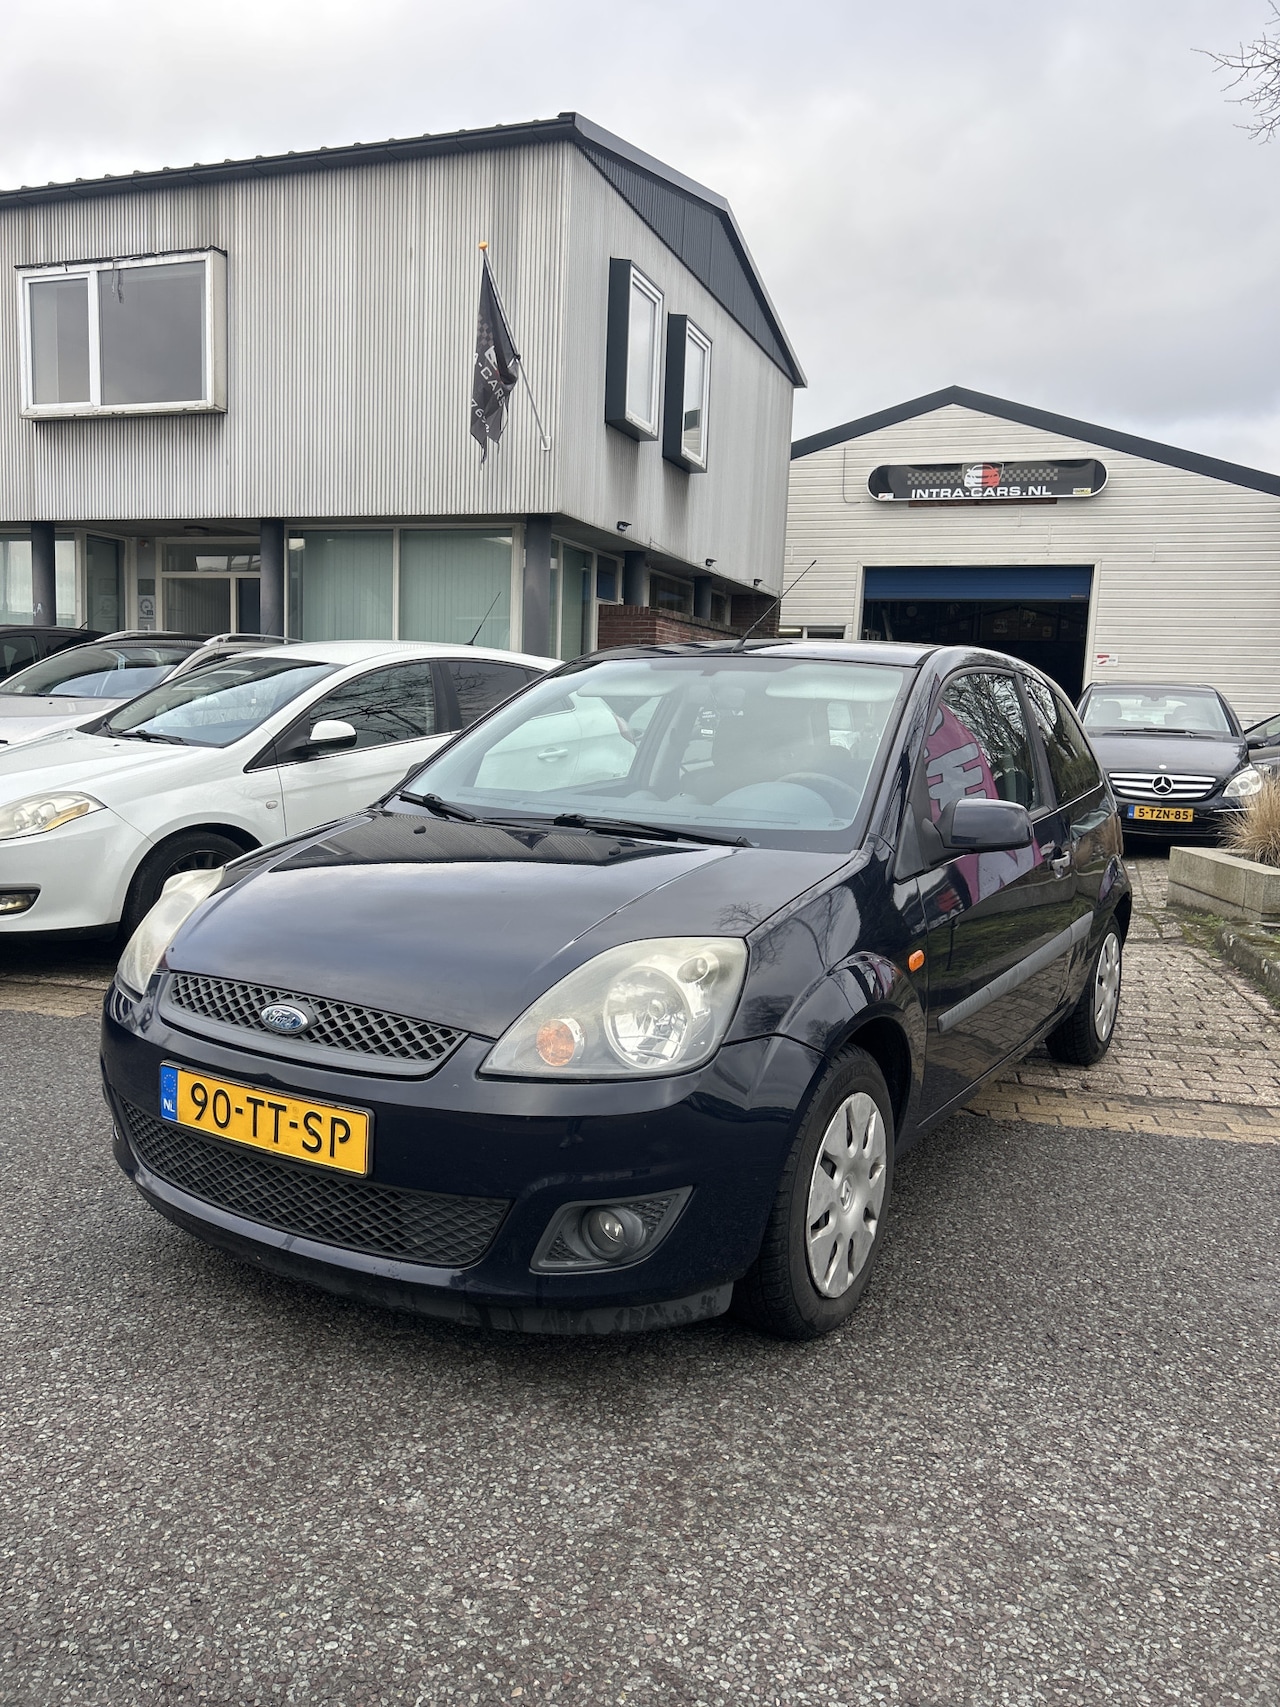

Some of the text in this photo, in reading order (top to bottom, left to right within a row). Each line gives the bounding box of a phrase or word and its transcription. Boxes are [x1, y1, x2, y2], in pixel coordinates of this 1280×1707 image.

[911, 485, 1052, 499] INTRA-CARS.NL
[1138, 807, 1189, 820] 5-TZN-85
[268, 1009, 297, 1028] Ford
[163, 1098, 176, 1113] NL
[190, 1082, 351, 1158] 90-TT-SP
